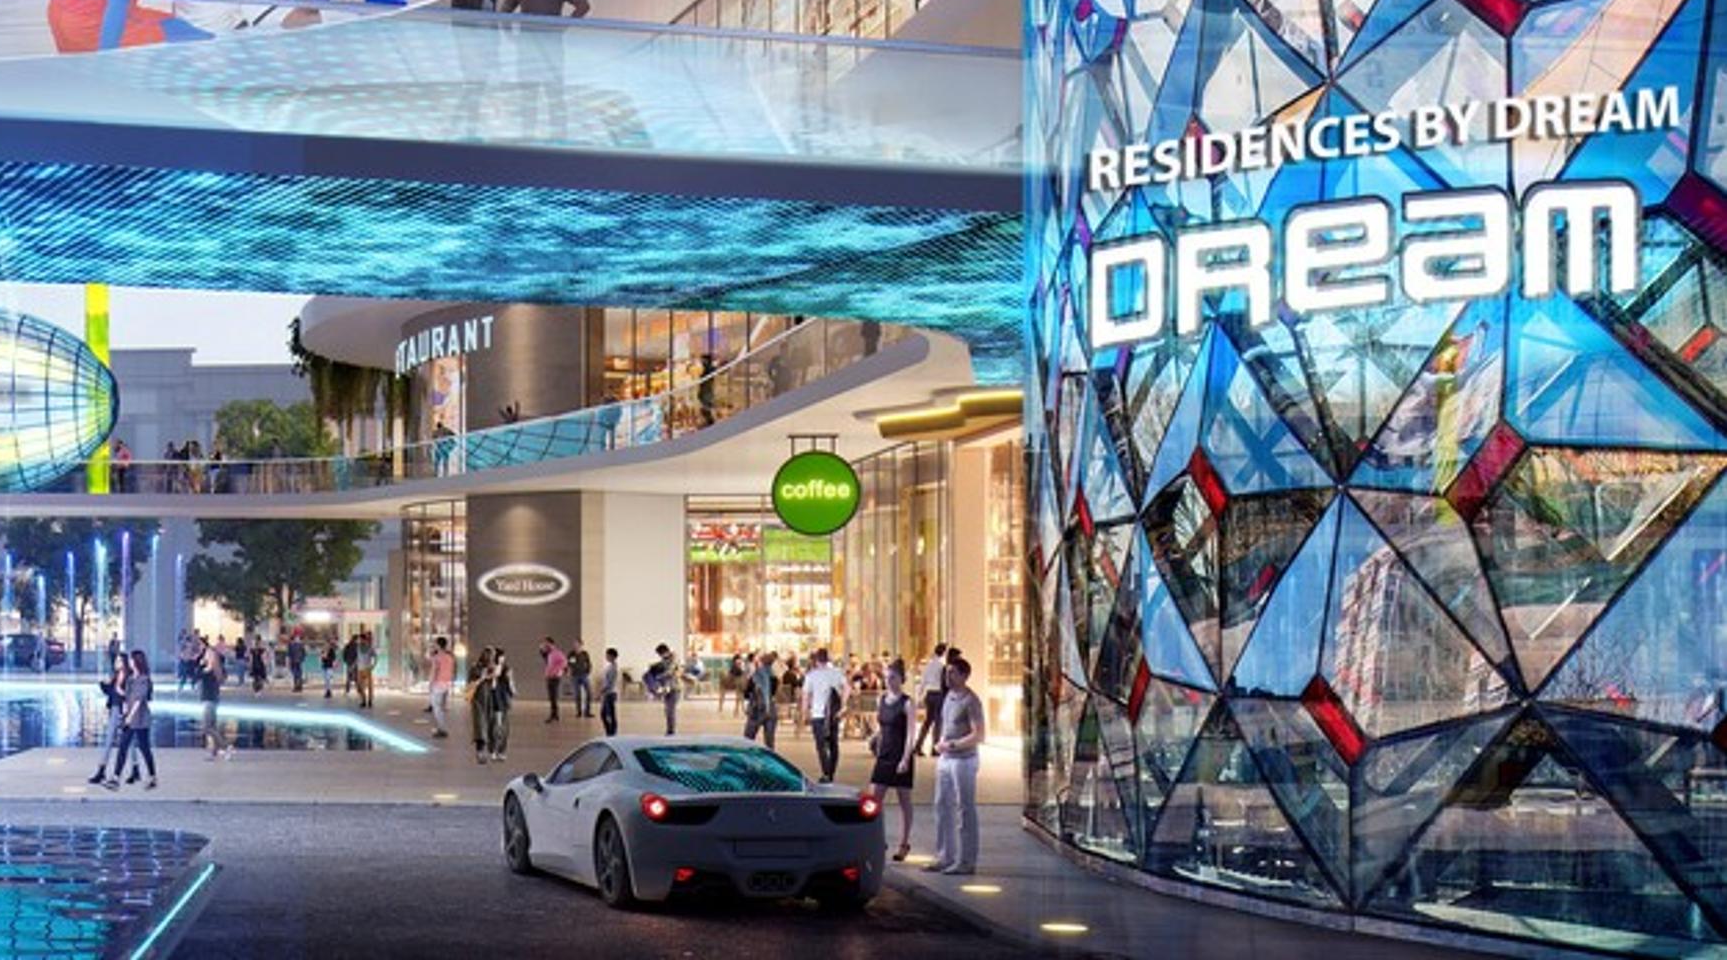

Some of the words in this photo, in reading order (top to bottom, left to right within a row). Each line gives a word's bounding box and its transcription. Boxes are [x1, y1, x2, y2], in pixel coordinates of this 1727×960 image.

[1087, 111, 1401, 191] RESIDENCES
[1414, 100, 1480, 150] BY
[1493, 85, 1681, 141] DREAM
[781, 479, 851, 500] coffee
